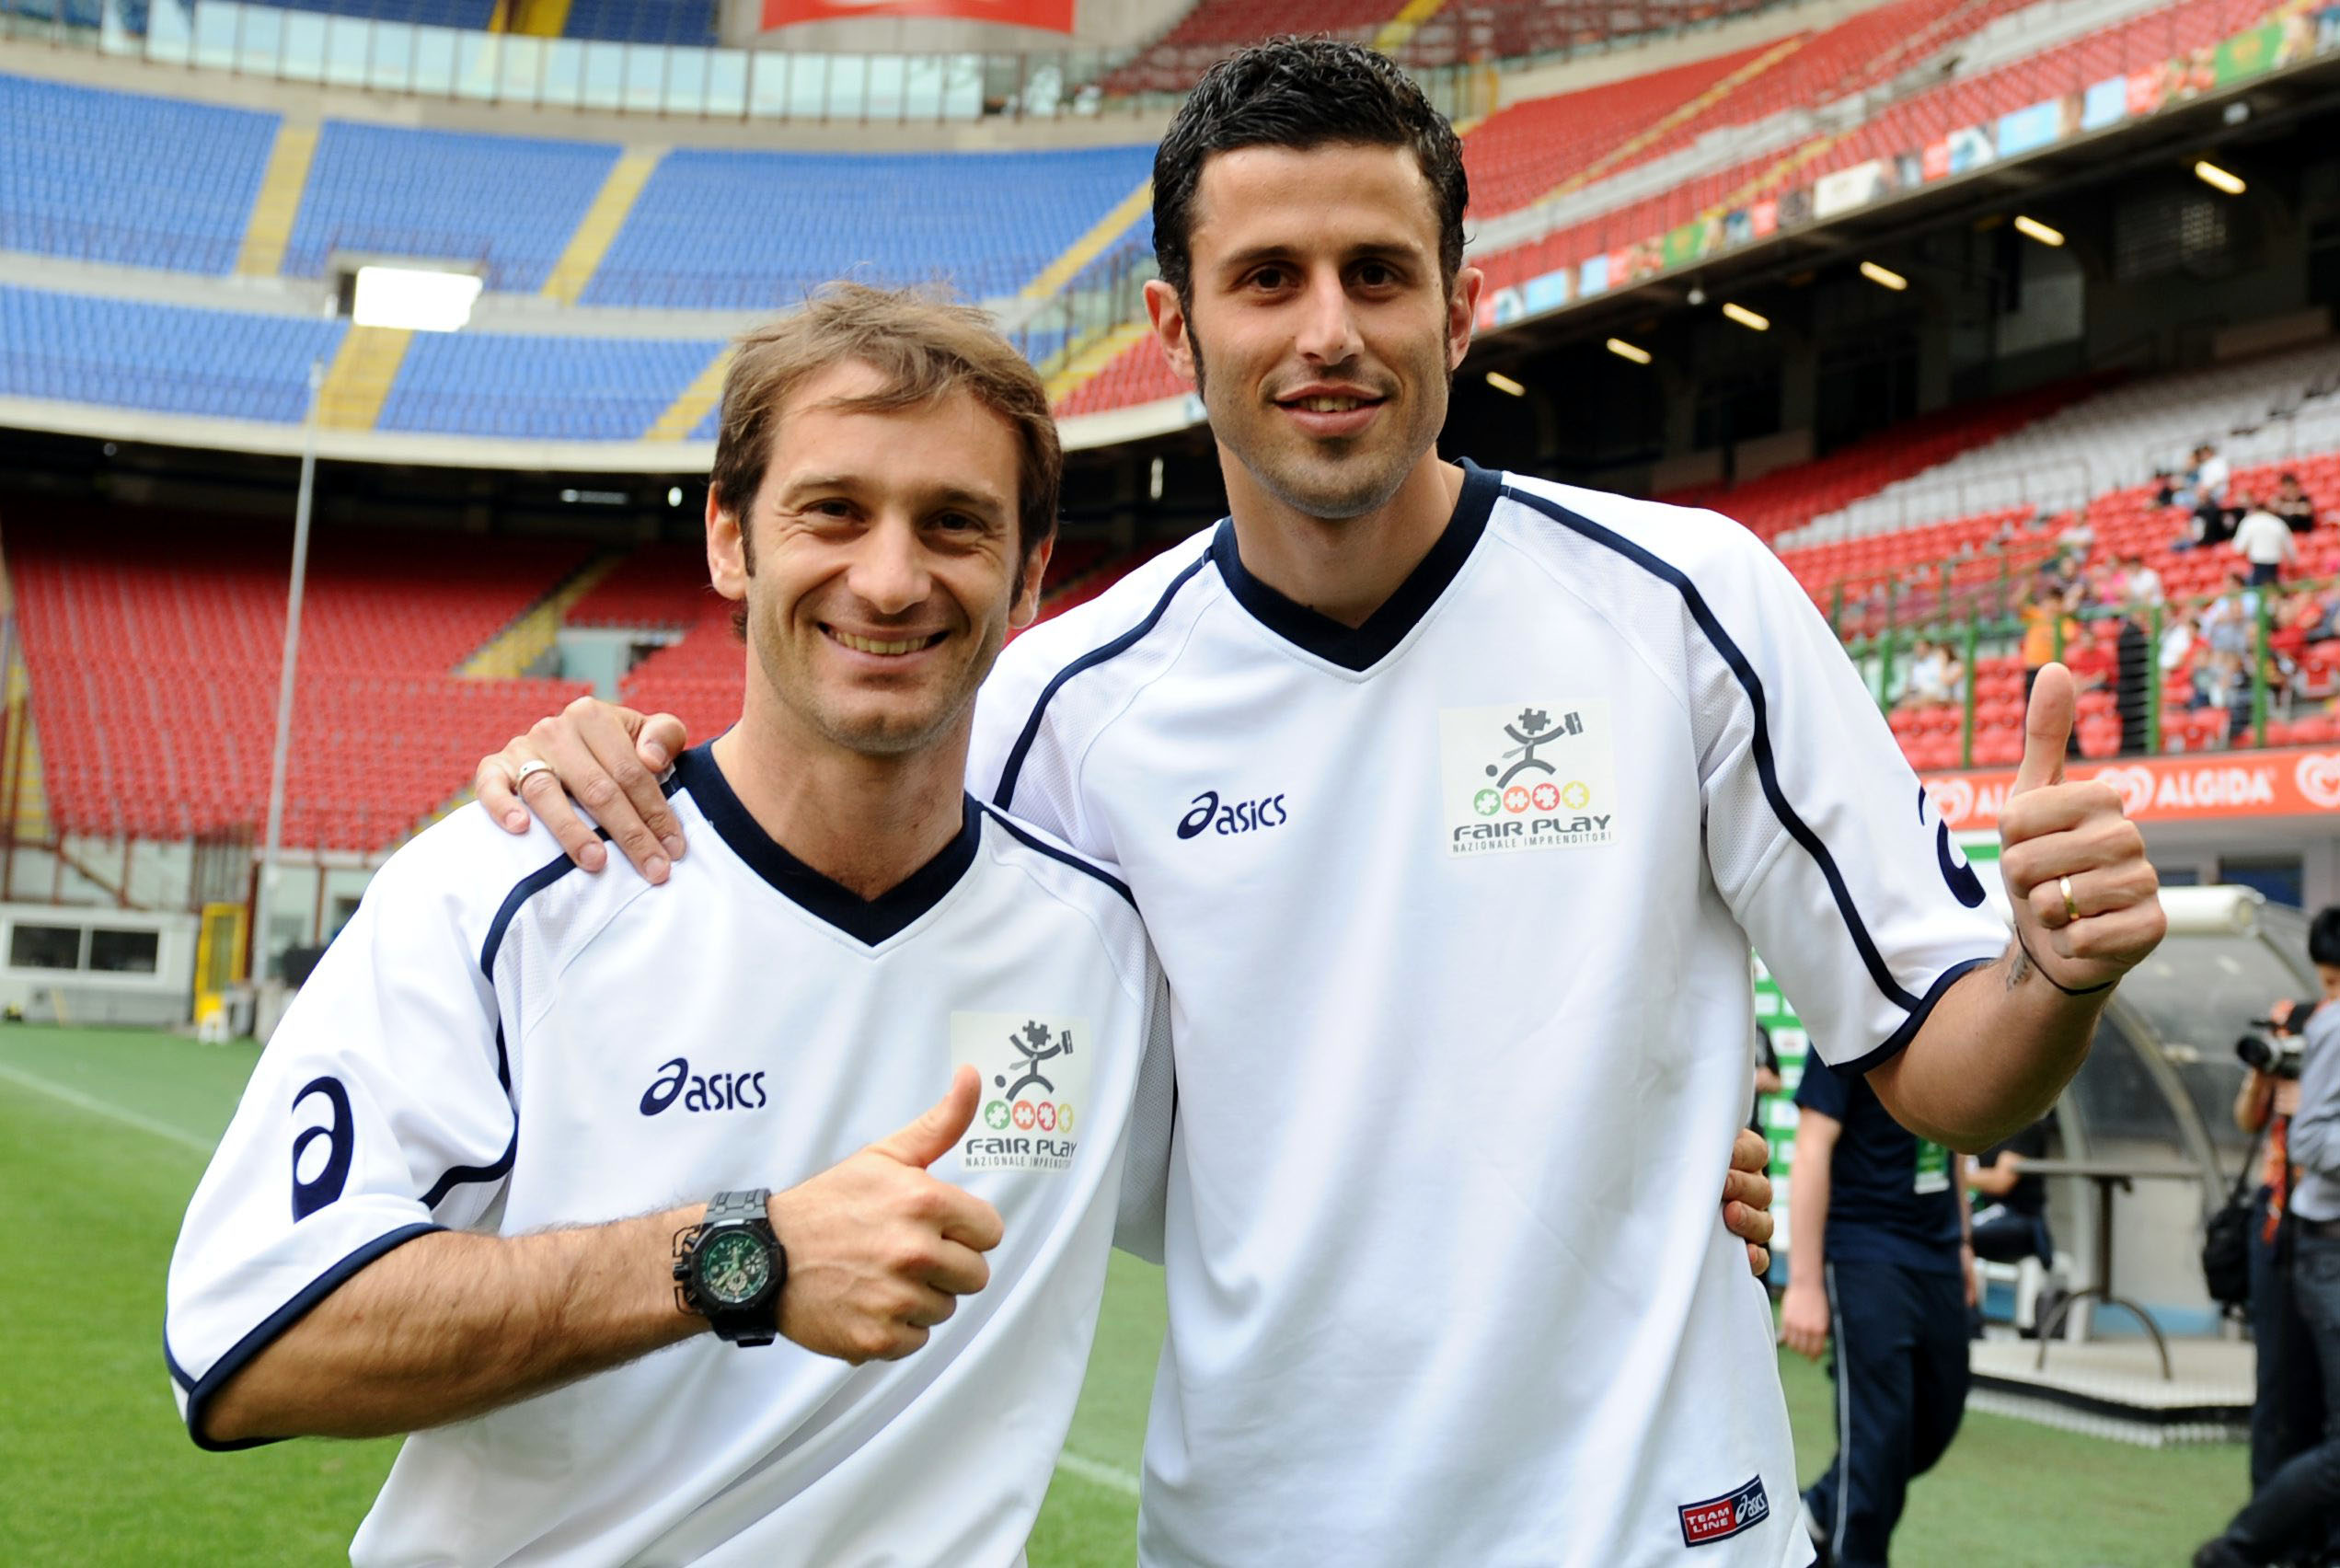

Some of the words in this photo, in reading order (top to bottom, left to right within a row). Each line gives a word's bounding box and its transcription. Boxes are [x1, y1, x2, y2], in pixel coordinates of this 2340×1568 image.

[2156, 767, 2276, 808] ALGIDA
[1452, 838, 1517, 853] NAZIONALE
[1524, 832, 1611, 847] IMPRENDITORI
[1686, 1506, 1730, 1526] TEAM
[1692, 1517, 1729, 1534] LINE
